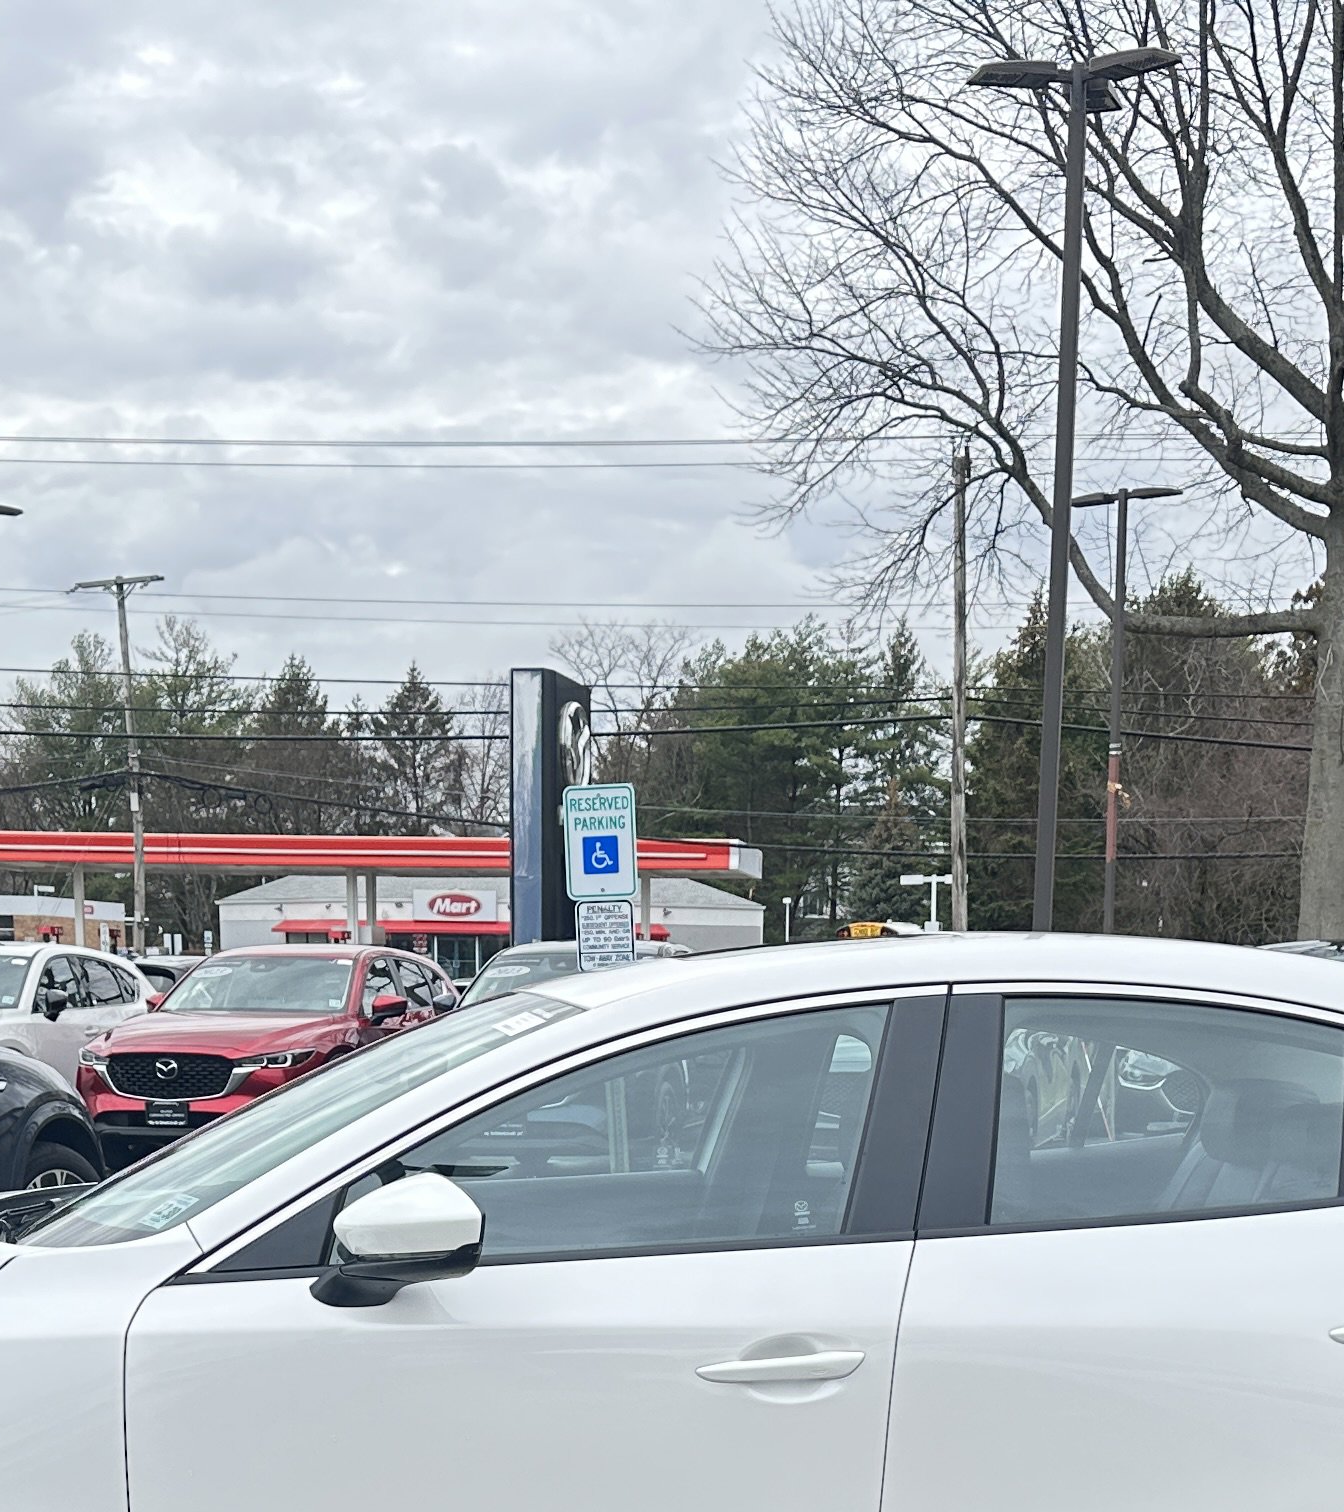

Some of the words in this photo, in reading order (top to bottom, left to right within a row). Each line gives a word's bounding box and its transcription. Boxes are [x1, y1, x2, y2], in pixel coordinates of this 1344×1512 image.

[569, 796, 629, 812] RESERVED
[574, 815, 626, 831] PARKING
[432, 897, 477, 914] Mart
[587, 904, 623, 914] PENALTY
